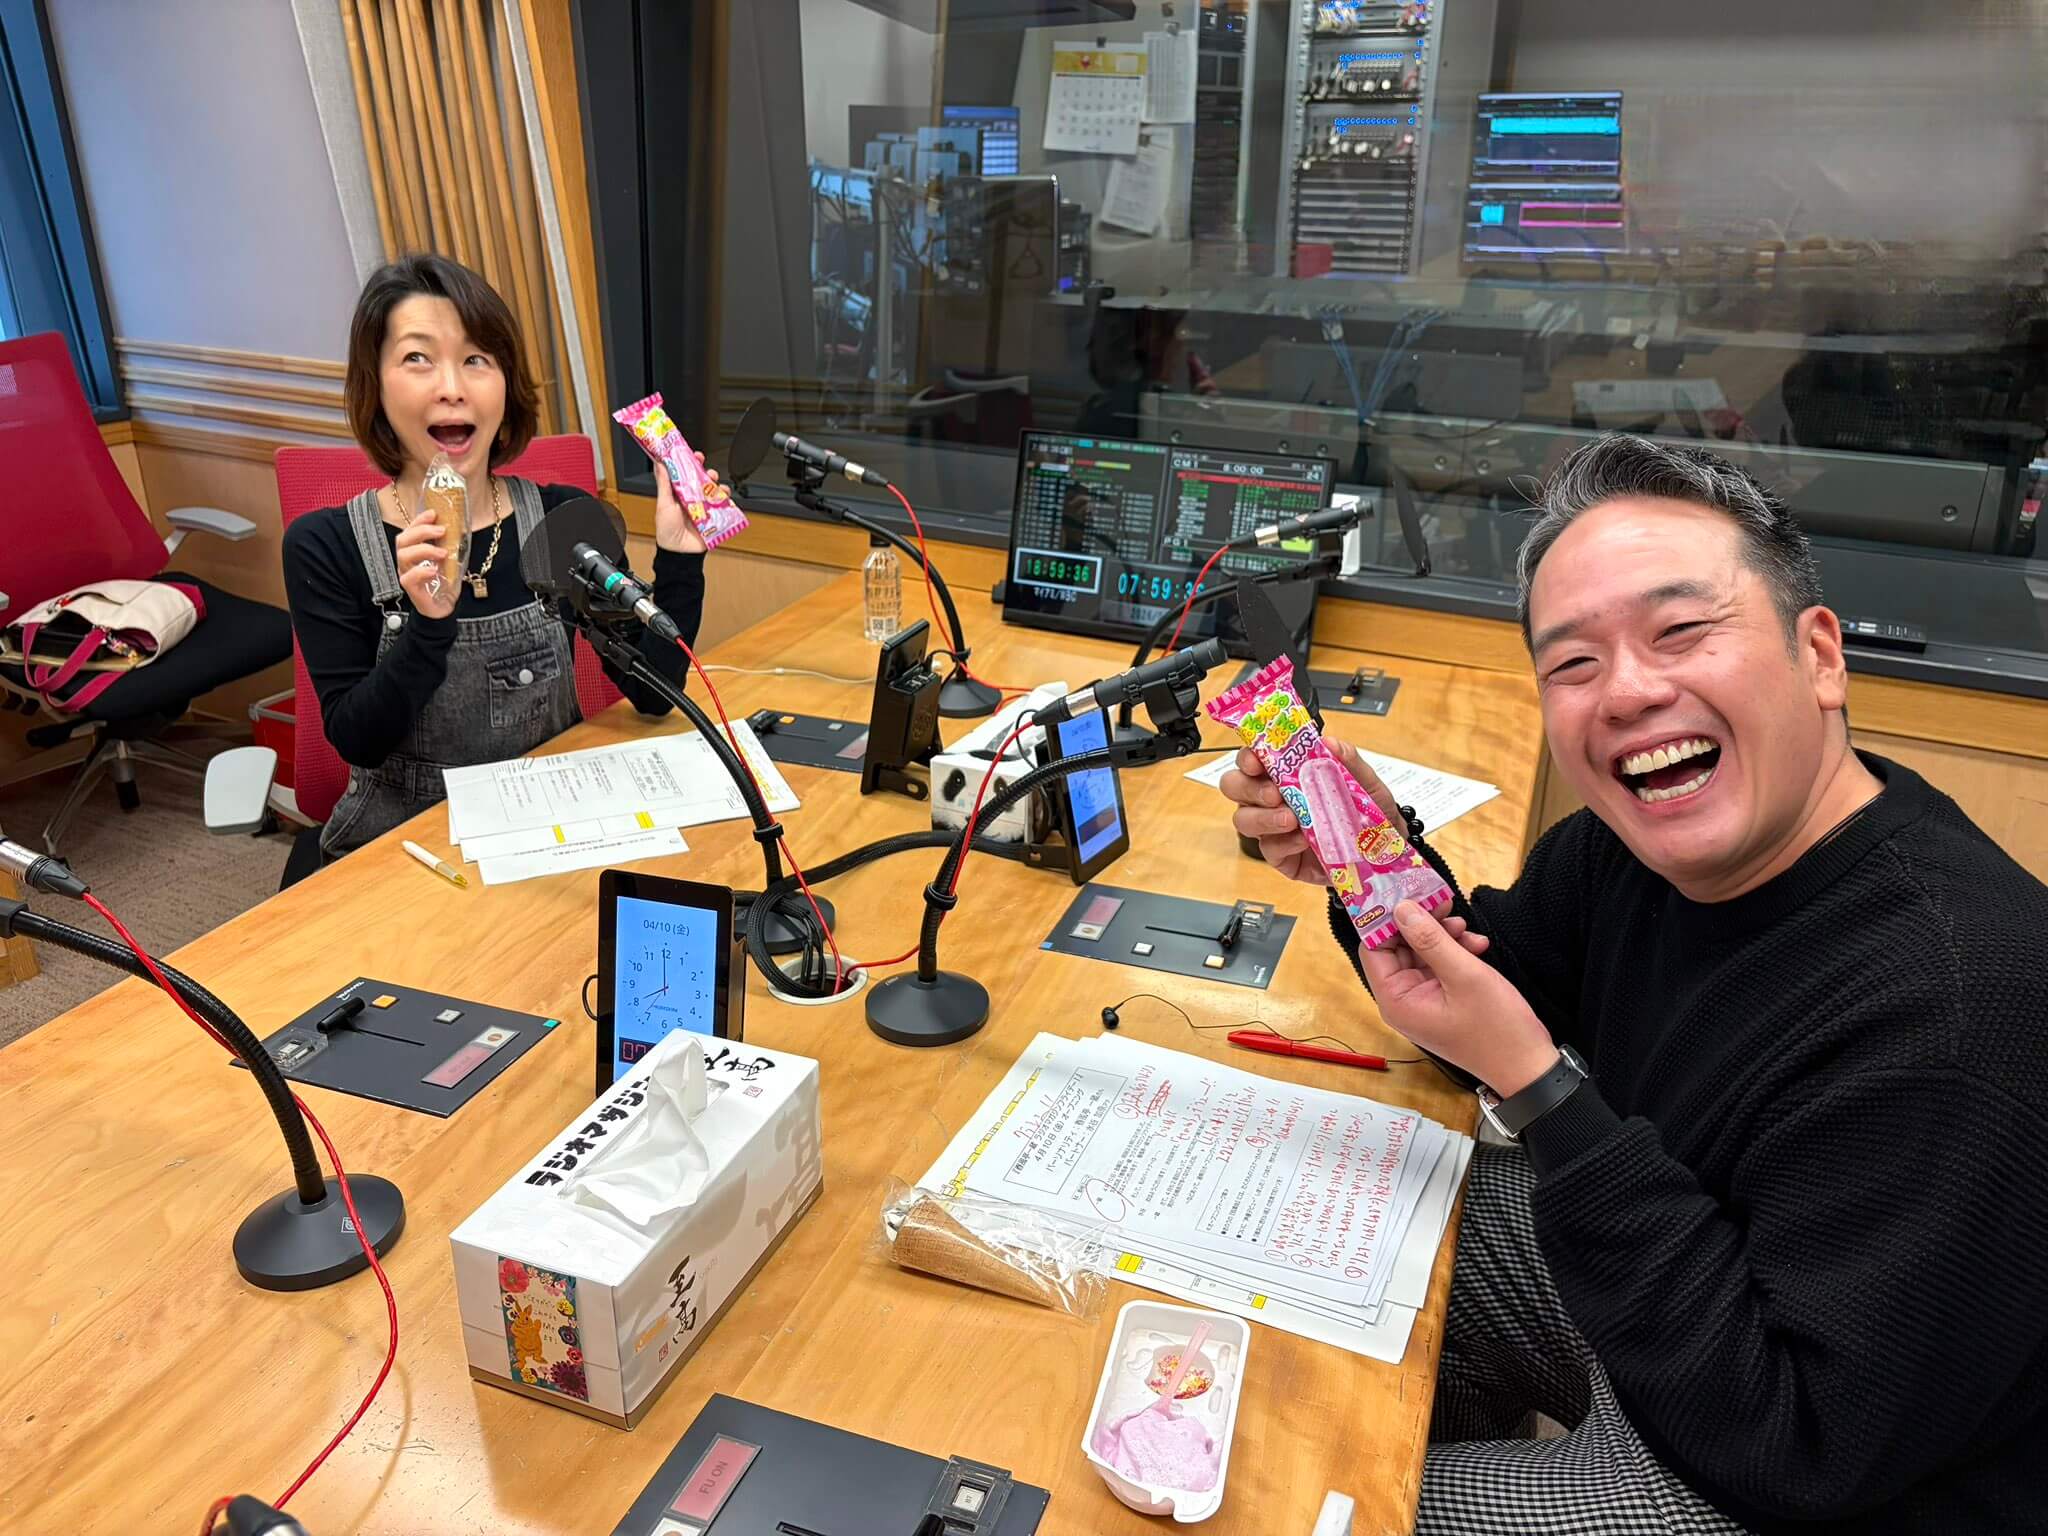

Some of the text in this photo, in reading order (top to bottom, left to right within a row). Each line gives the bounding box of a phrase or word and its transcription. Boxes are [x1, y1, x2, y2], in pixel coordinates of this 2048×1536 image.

[1026, 559, 1091, 582] 18:59:36
[643, 919, 670, 933] 04/10
[645, 951, 655, 961] 11
[661, 948, 672, 960] 12
[680, 957, 685, 966] 1
[632, 962, 643, 972] 10
[691, 972, 697, 981] 2
[629, 979, 636, 988] 9
[695, 991, 701, 1000] 3
[634, 997, 640, 1006] 8
[690, 1006, 696, 1016] 4
[645, 1011, 652, 1021] 7
[661, 1020, 668, 1029] 6
[677, 1018, 683, 1027] 5
